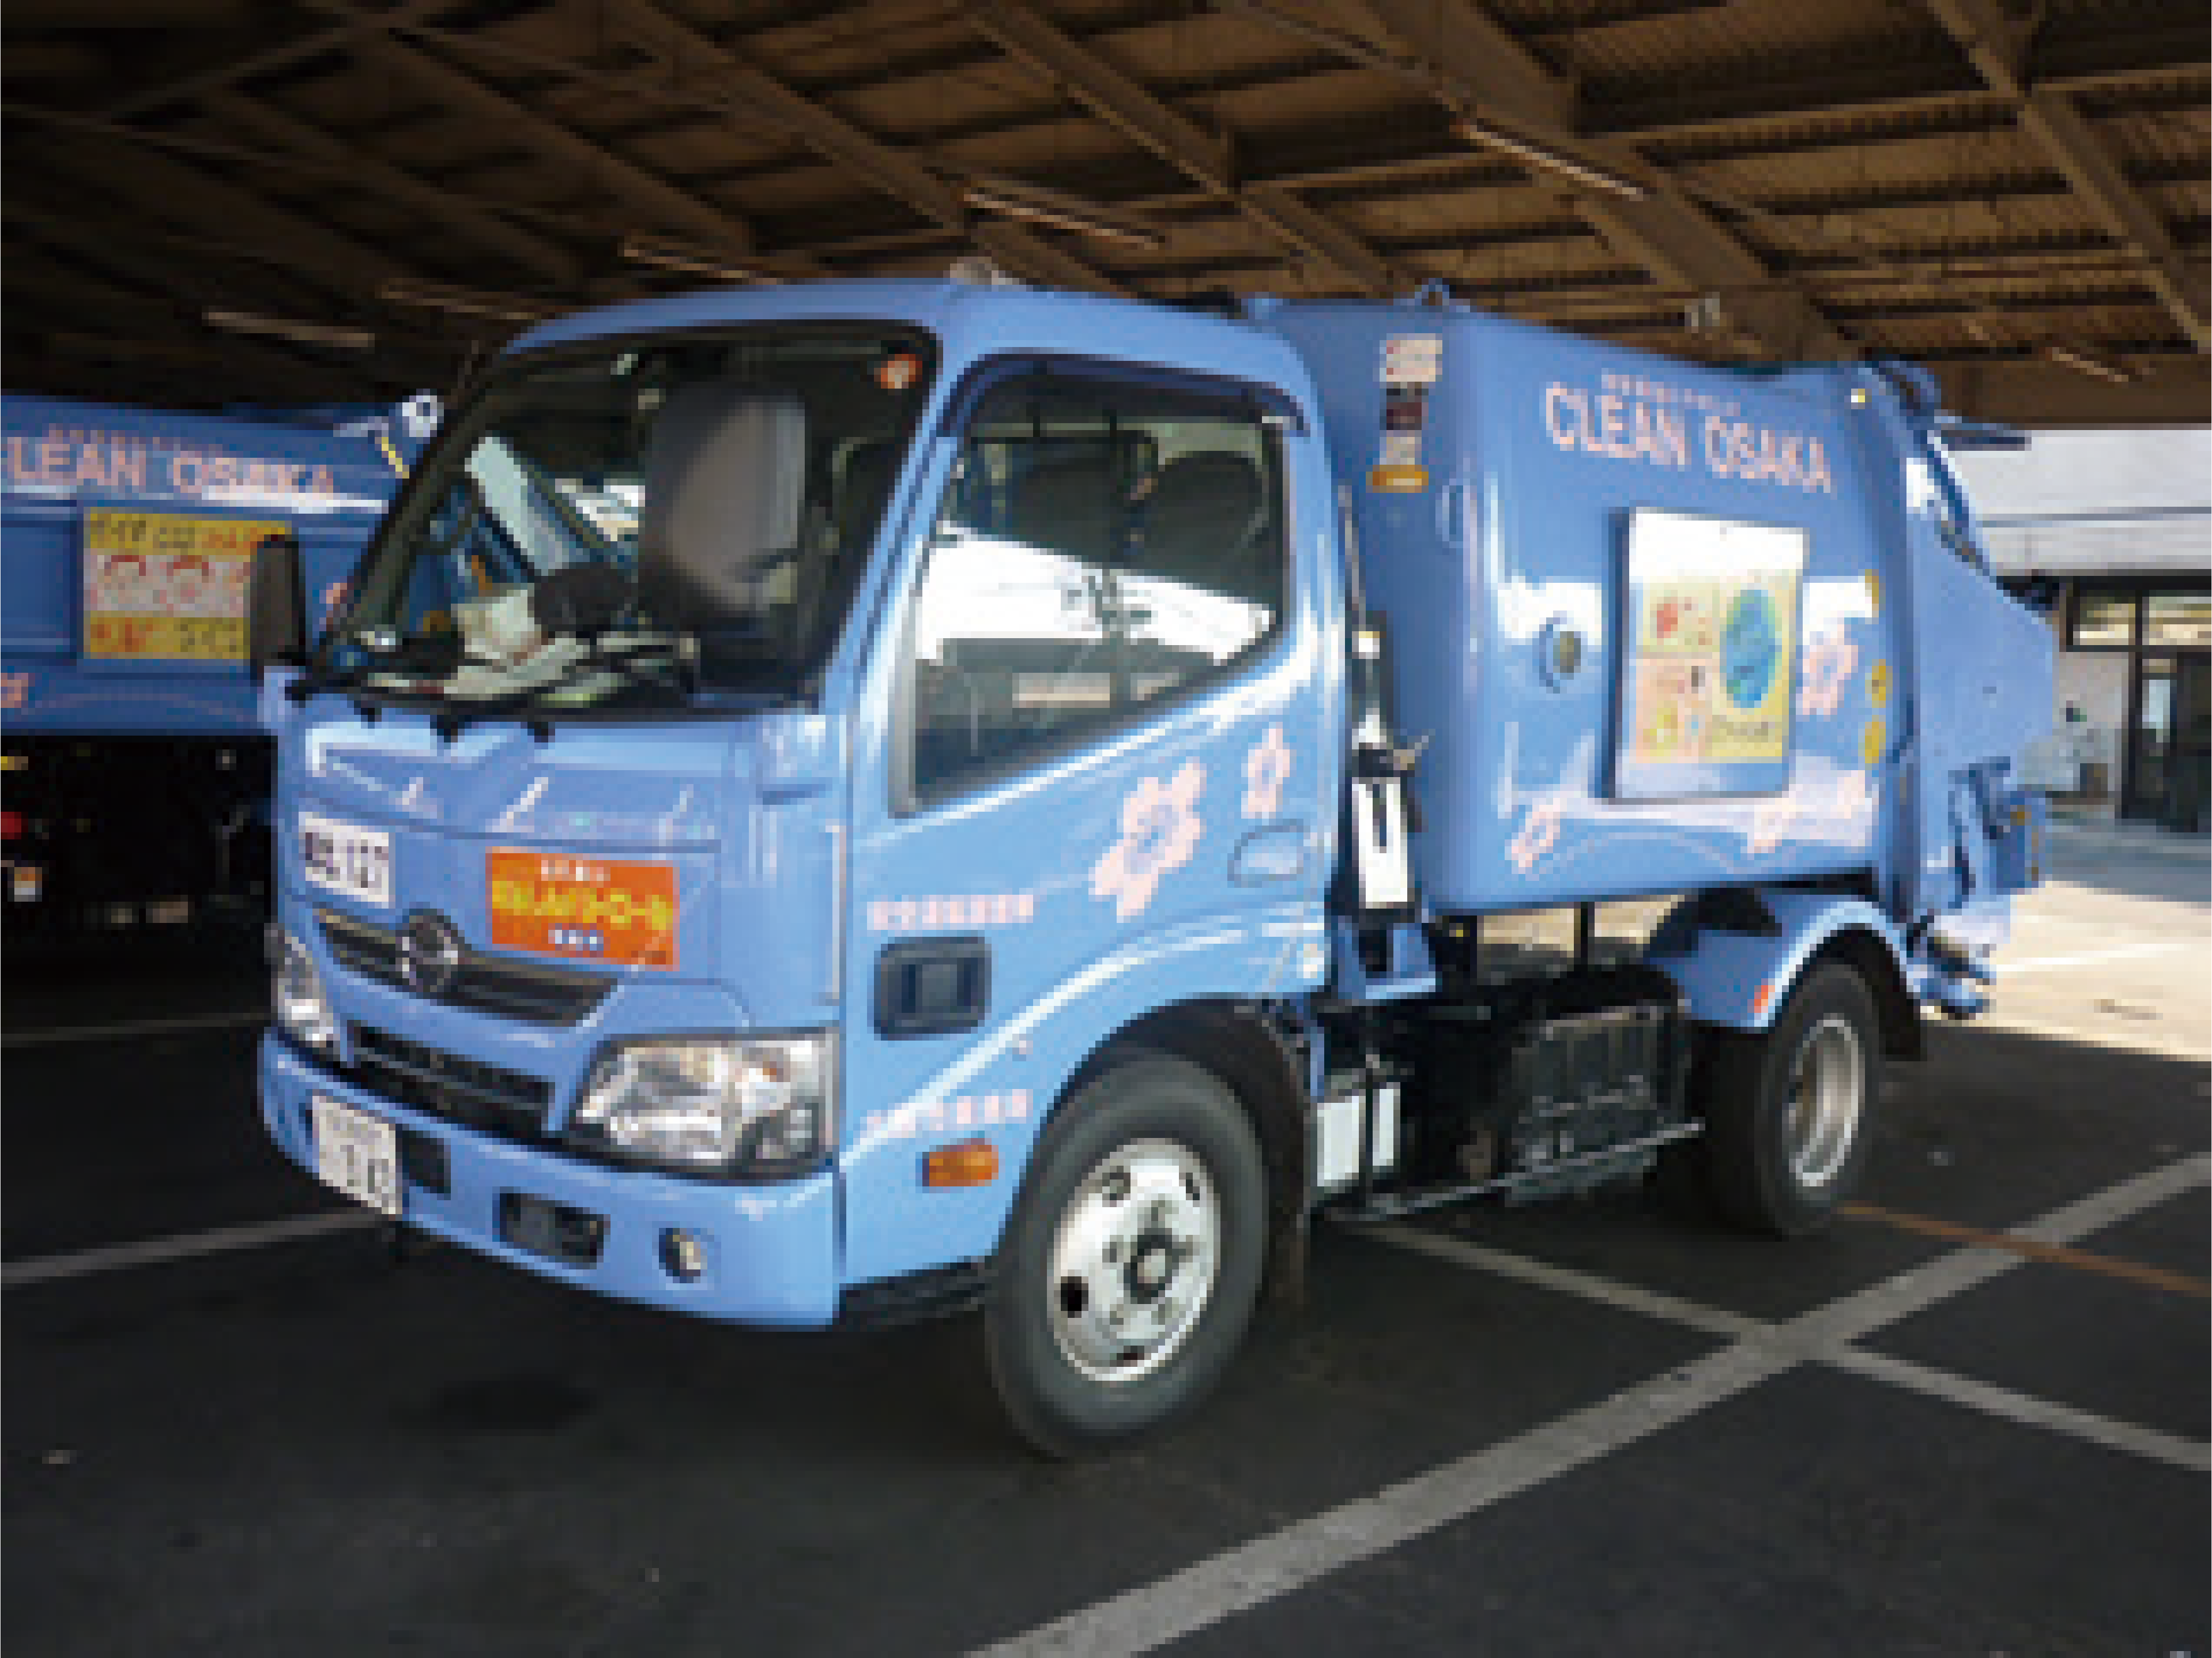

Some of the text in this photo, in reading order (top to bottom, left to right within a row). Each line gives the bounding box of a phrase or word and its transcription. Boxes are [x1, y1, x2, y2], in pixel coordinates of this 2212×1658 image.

[1, 436, 146, 488] LEAN
[173, 452, 334, 498] OSAKA
[1545, 382, 1689, 468] CLEAN
[1704, 415, 1832, 492] OSAKA
